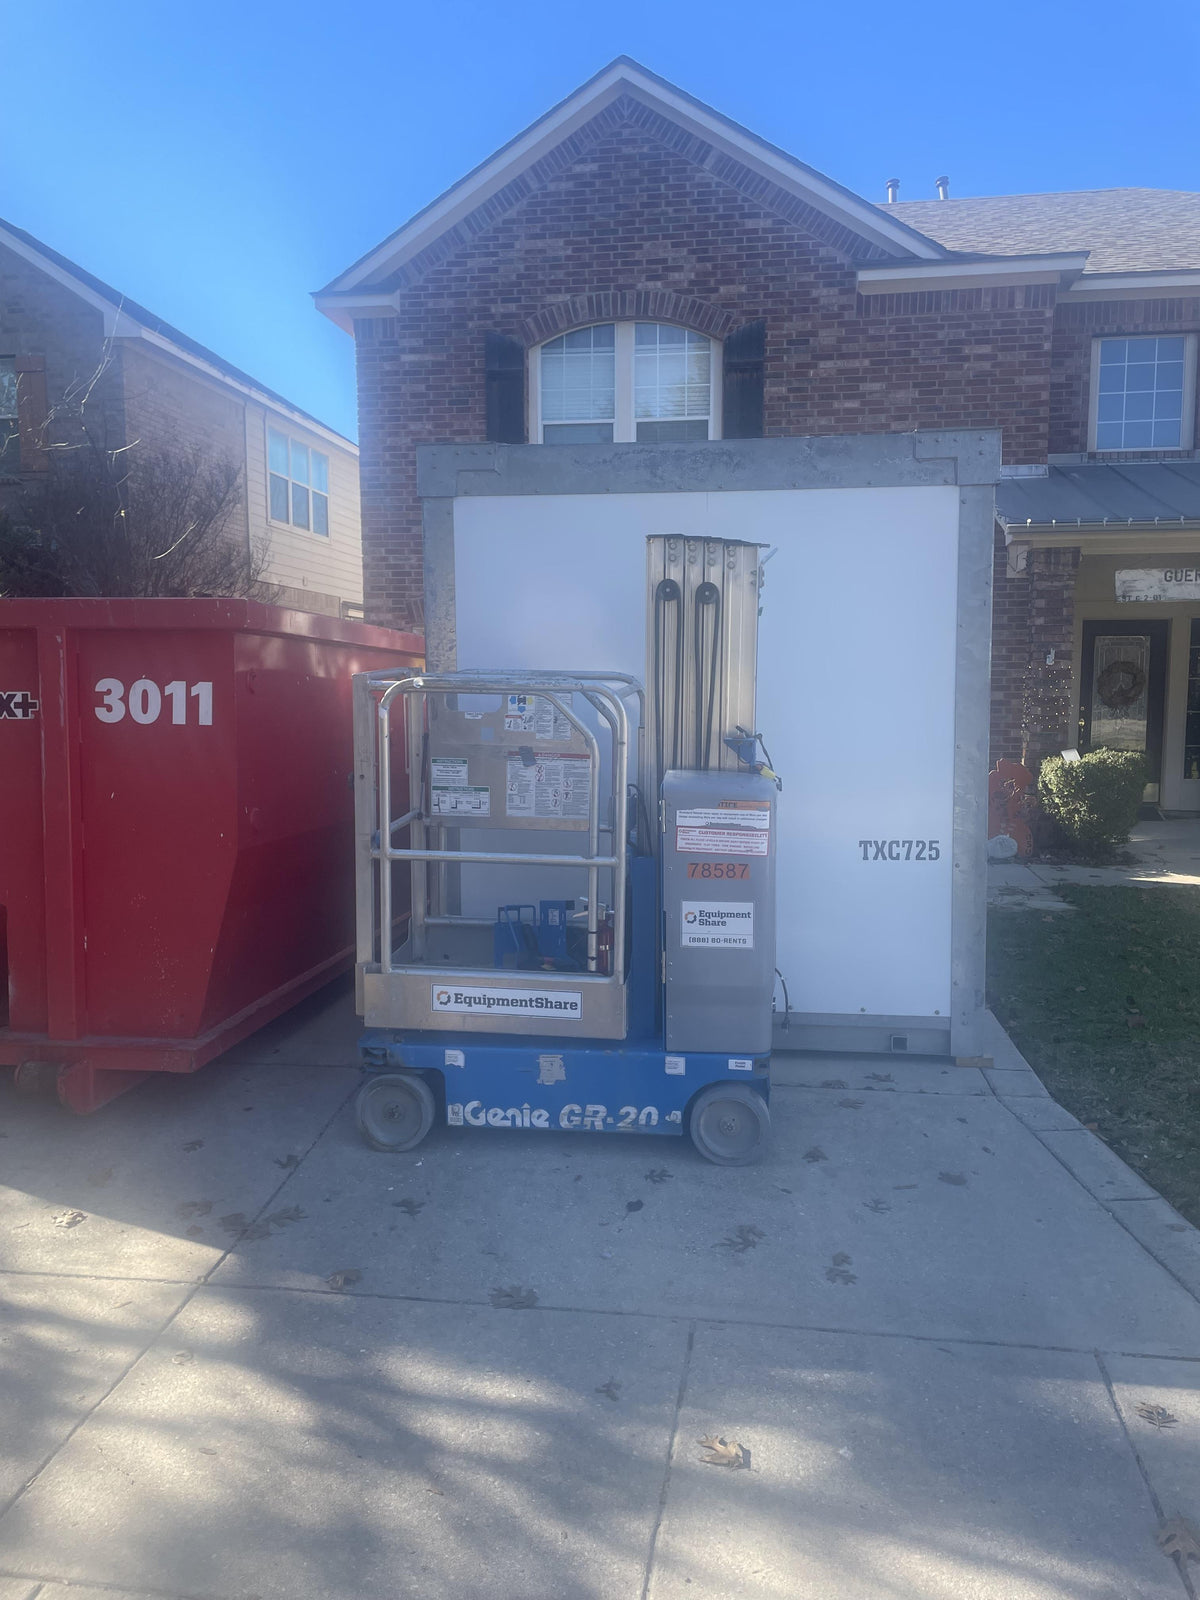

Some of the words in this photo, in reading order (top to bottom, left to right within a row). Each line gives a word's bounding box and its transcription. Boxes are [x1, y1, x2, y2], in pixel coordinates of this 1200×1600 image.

[94, 677, 213, 726] 3011
[859, 840, 940, 861] TXC725
[689, 862, 749, 879] 78587
[698, 910, 752, 920] Equipment
[698, 918, 727, 927] Share
[688, 936, 709, 944] (888)
[453, 992, 578, 1011] EquipmentShare
[464, 1100, 550, 1128] Genie
[558, 1103, 659, 1130] GR-20
